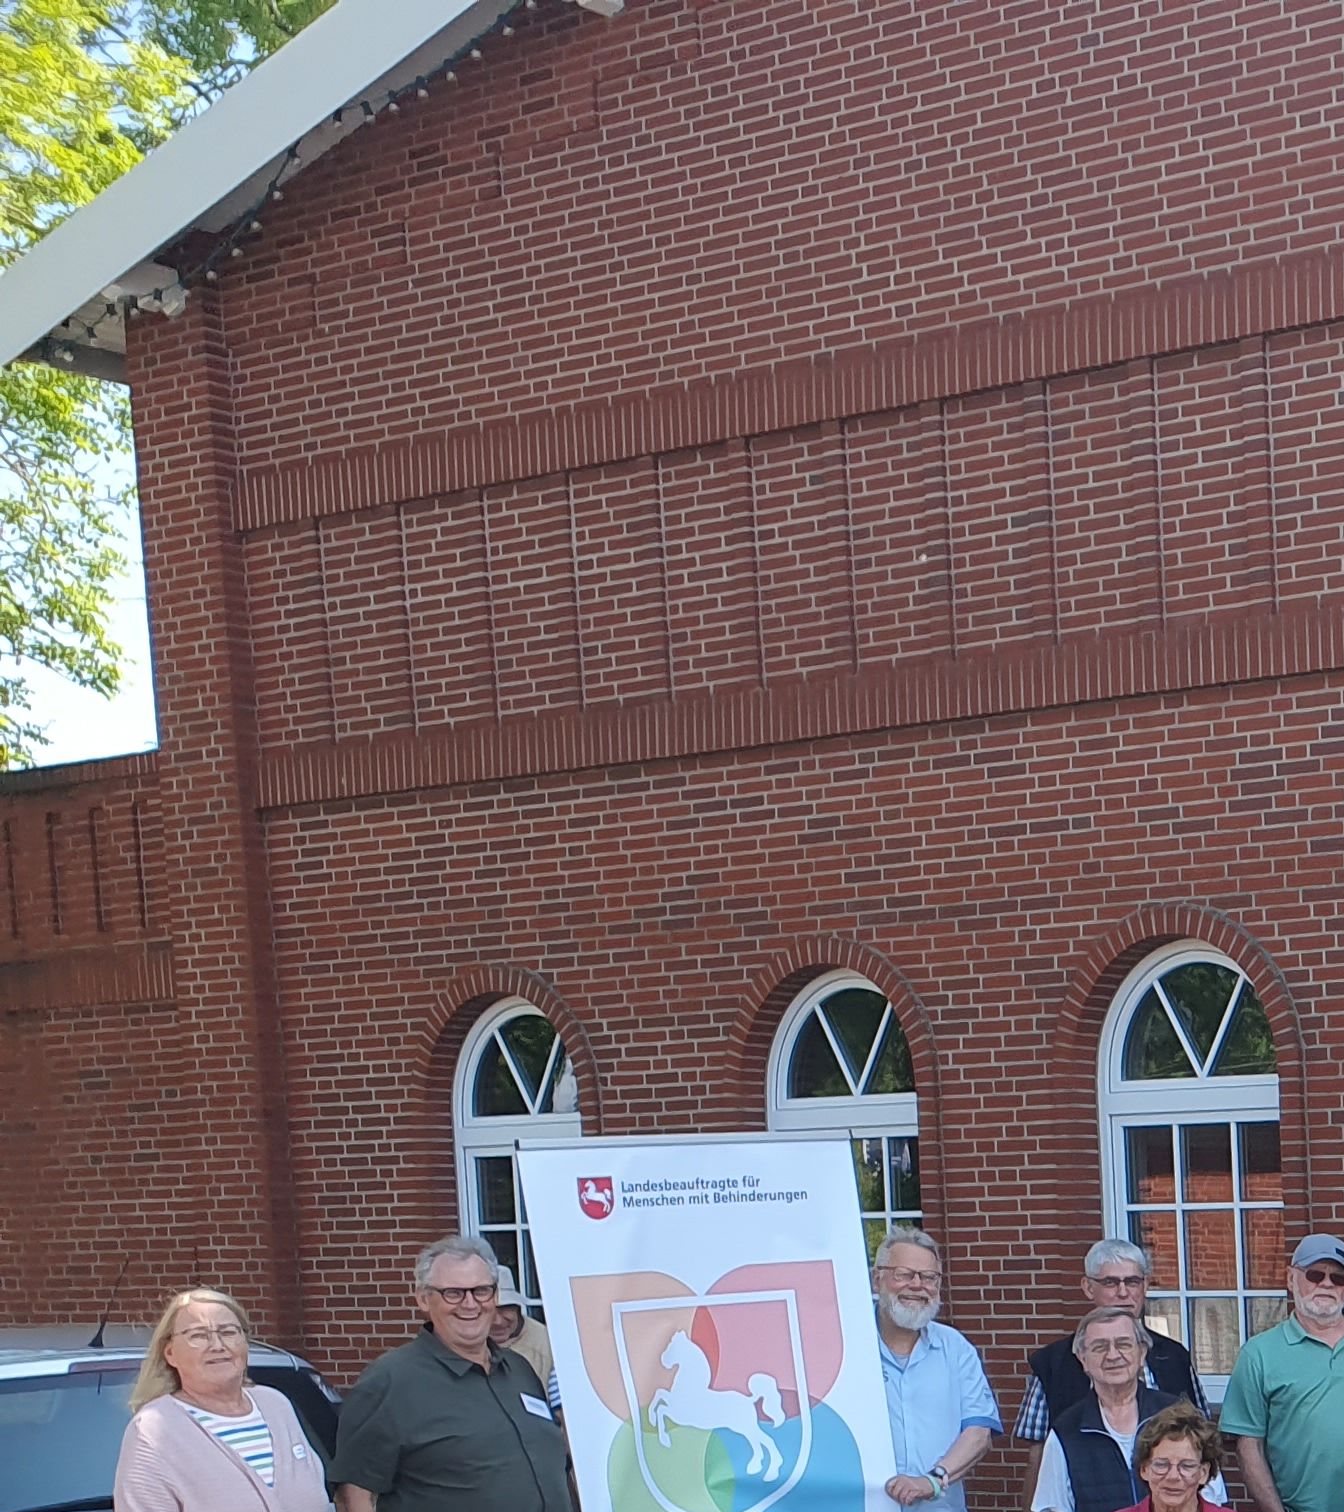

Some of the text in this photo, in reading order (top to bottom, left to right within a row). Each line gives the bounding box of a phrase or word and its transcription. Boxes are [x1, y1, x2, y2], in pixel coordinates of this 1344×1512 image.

[621, 1175, 760, 1193] Landesbeauftragte für
[622, 1190, 808, 1208] Menschen mit Behinderungen
